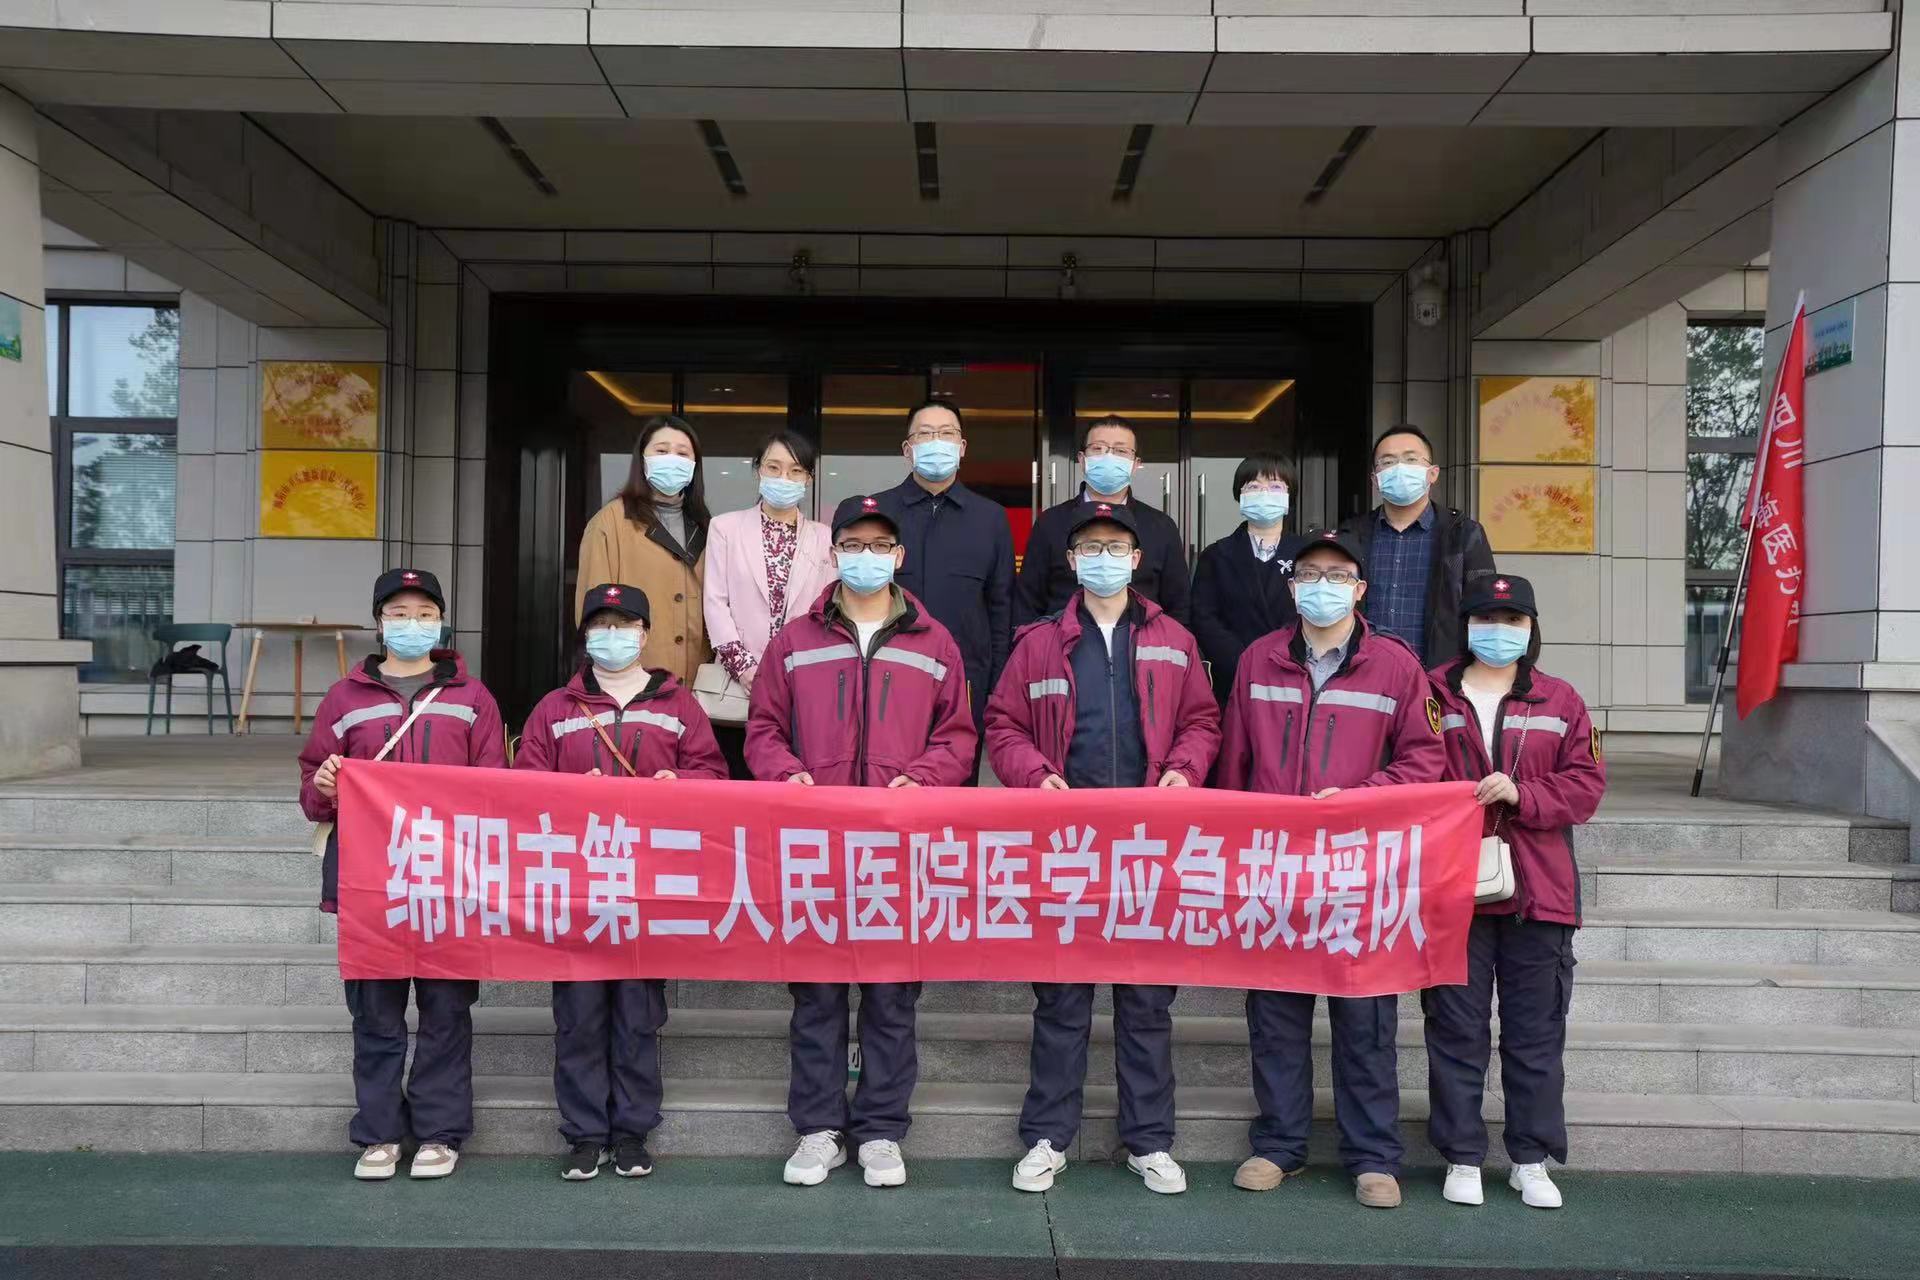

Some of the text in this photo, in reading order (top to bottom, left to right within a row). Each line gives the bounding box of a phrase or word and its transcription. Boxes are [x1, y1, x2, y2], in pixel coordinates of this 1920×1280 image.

[385, 804, 1428, 958] 绵阳市第三人民医院医学应急救援队
